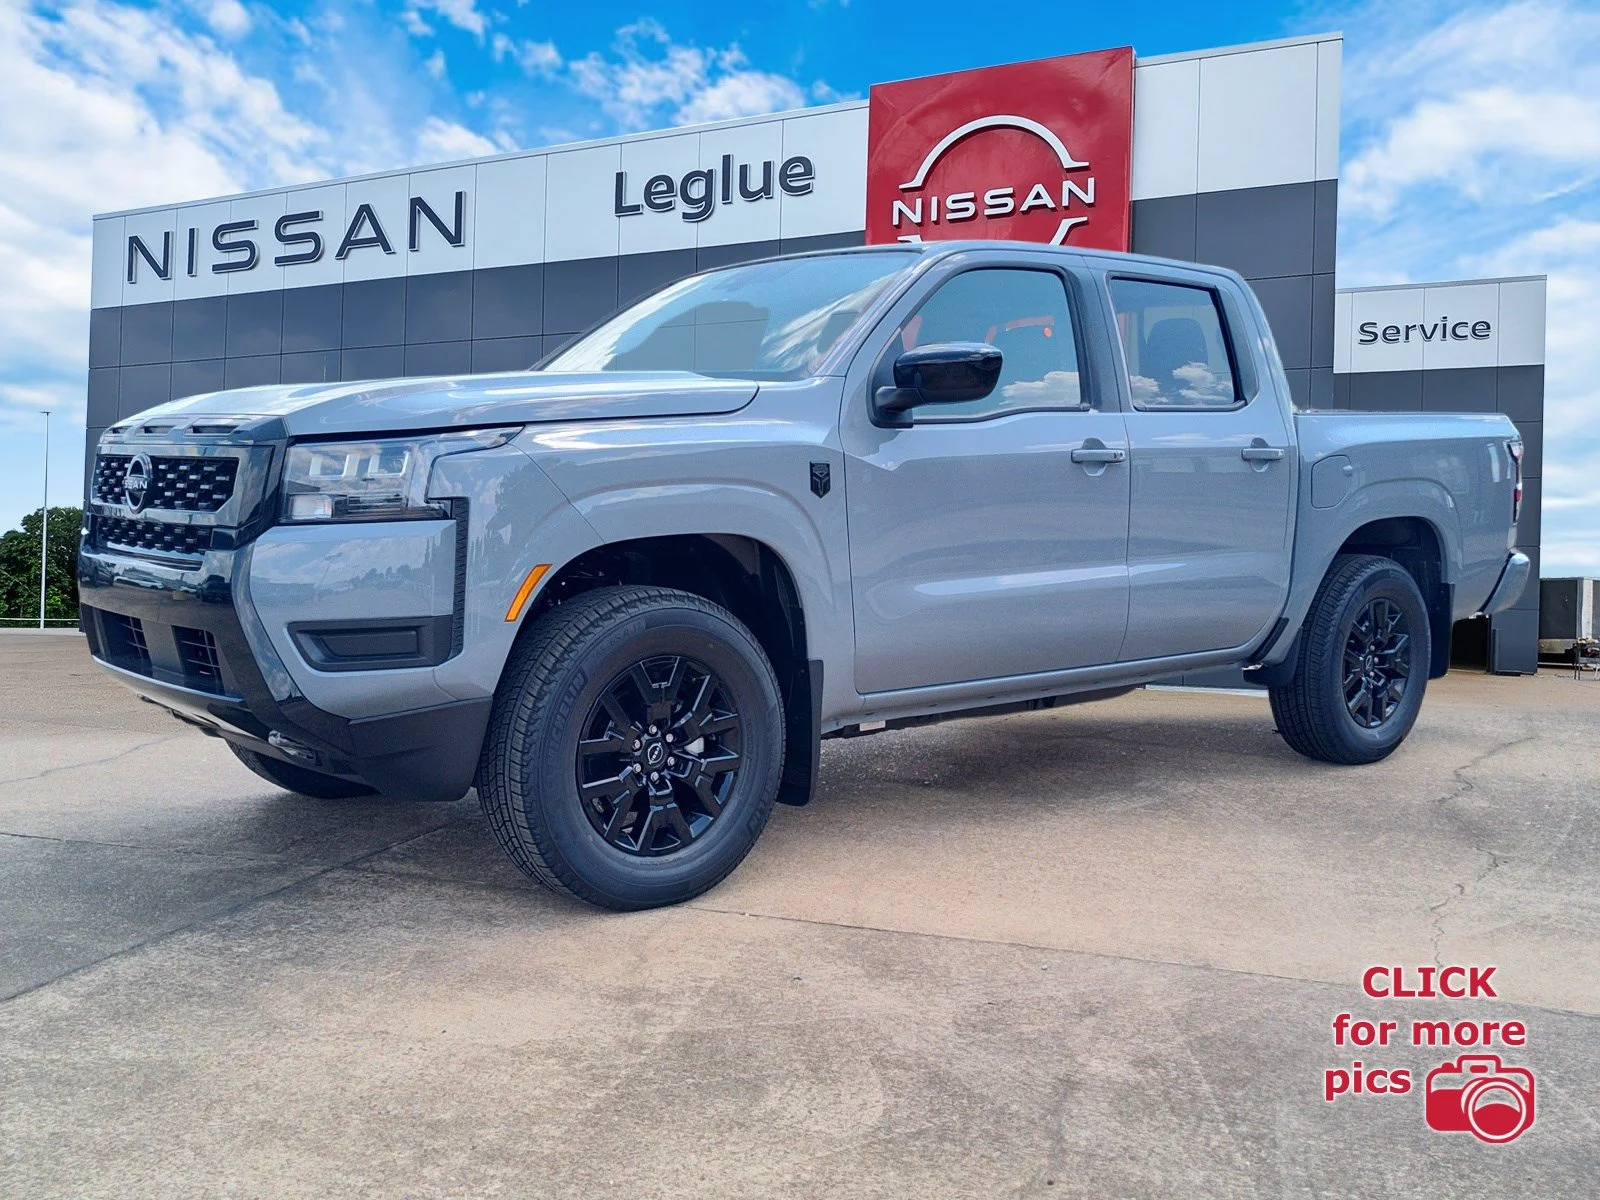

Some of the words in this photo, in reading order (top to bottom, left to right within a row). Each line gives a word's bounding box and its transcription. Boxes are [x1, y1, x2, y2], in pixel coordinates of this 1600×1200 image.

[614, 153, 815, 223] Leglue
[892, 176, 1095, 226] NISSAN
[127, 190, 467, 284] NISSAN
[1358, 316, 1492, 345] Service
[122, 479, 148, 490] SSAN
